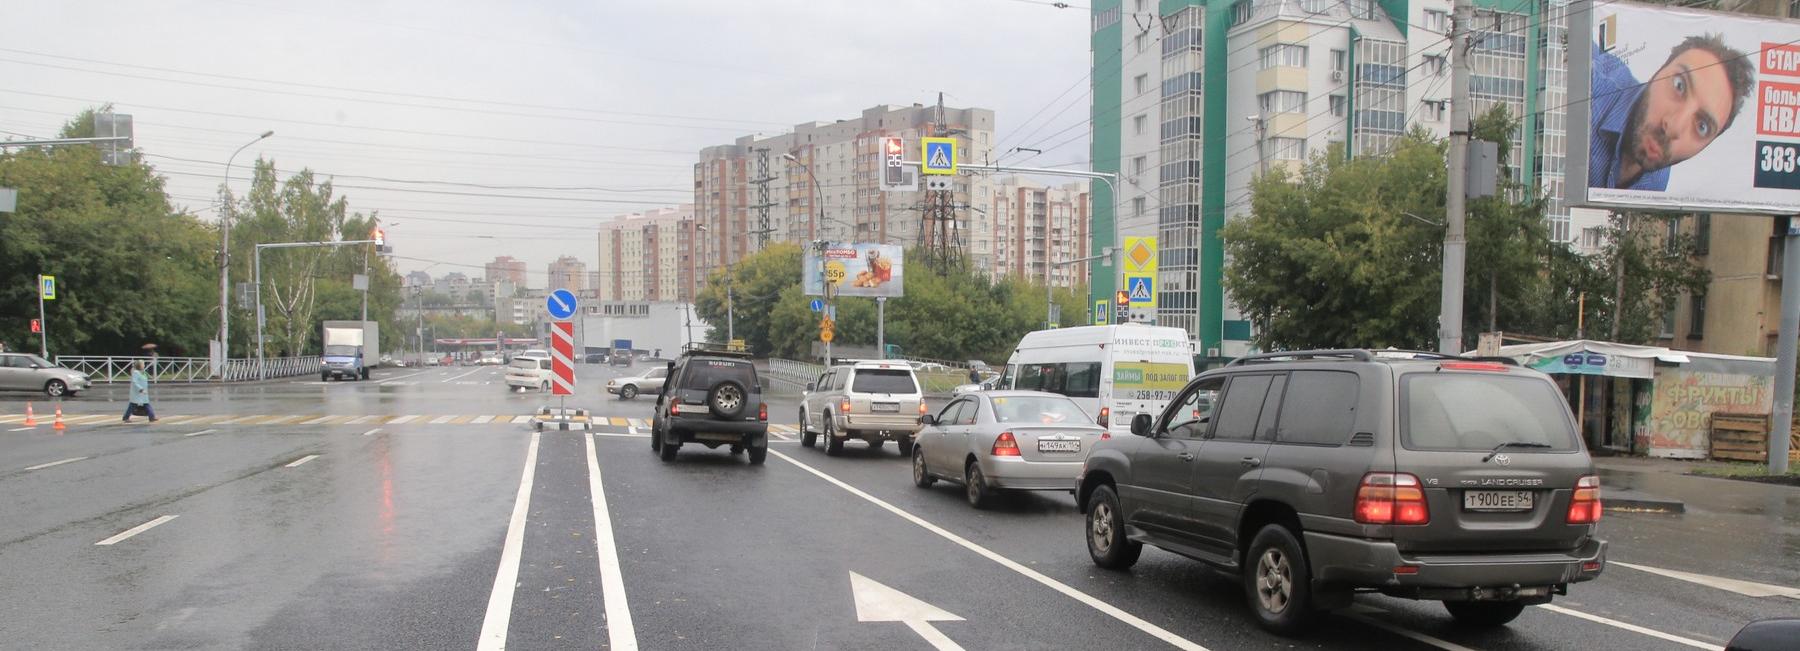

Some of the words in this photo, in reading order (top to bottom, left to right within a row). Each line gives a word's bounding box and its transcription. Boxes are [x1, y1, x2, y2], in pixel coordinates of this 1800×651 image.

[1766, 49, 1800, 72] СТАР
[1765, 86, 1800, 106] боль
[888, 154, 902, 167] 26
[1114, 339, 1149, 347] ИНВЕСТ
[1116, 370, 1140, 380] ЗАЙМЫ
[1145, 373, 1158, 382] ПОД
[1160, 374, 1177, 382] ЗАЛОГ
[1668, 384, 1757, 404] ФРУКТЫ
[1481, 478, 1505, 486] LAND
[1506, 478, 1543, 486] CRUISER
[1470, 492, 1514, 507] Т900ЕЕ
[1517, 491, 1529, 503] 54
